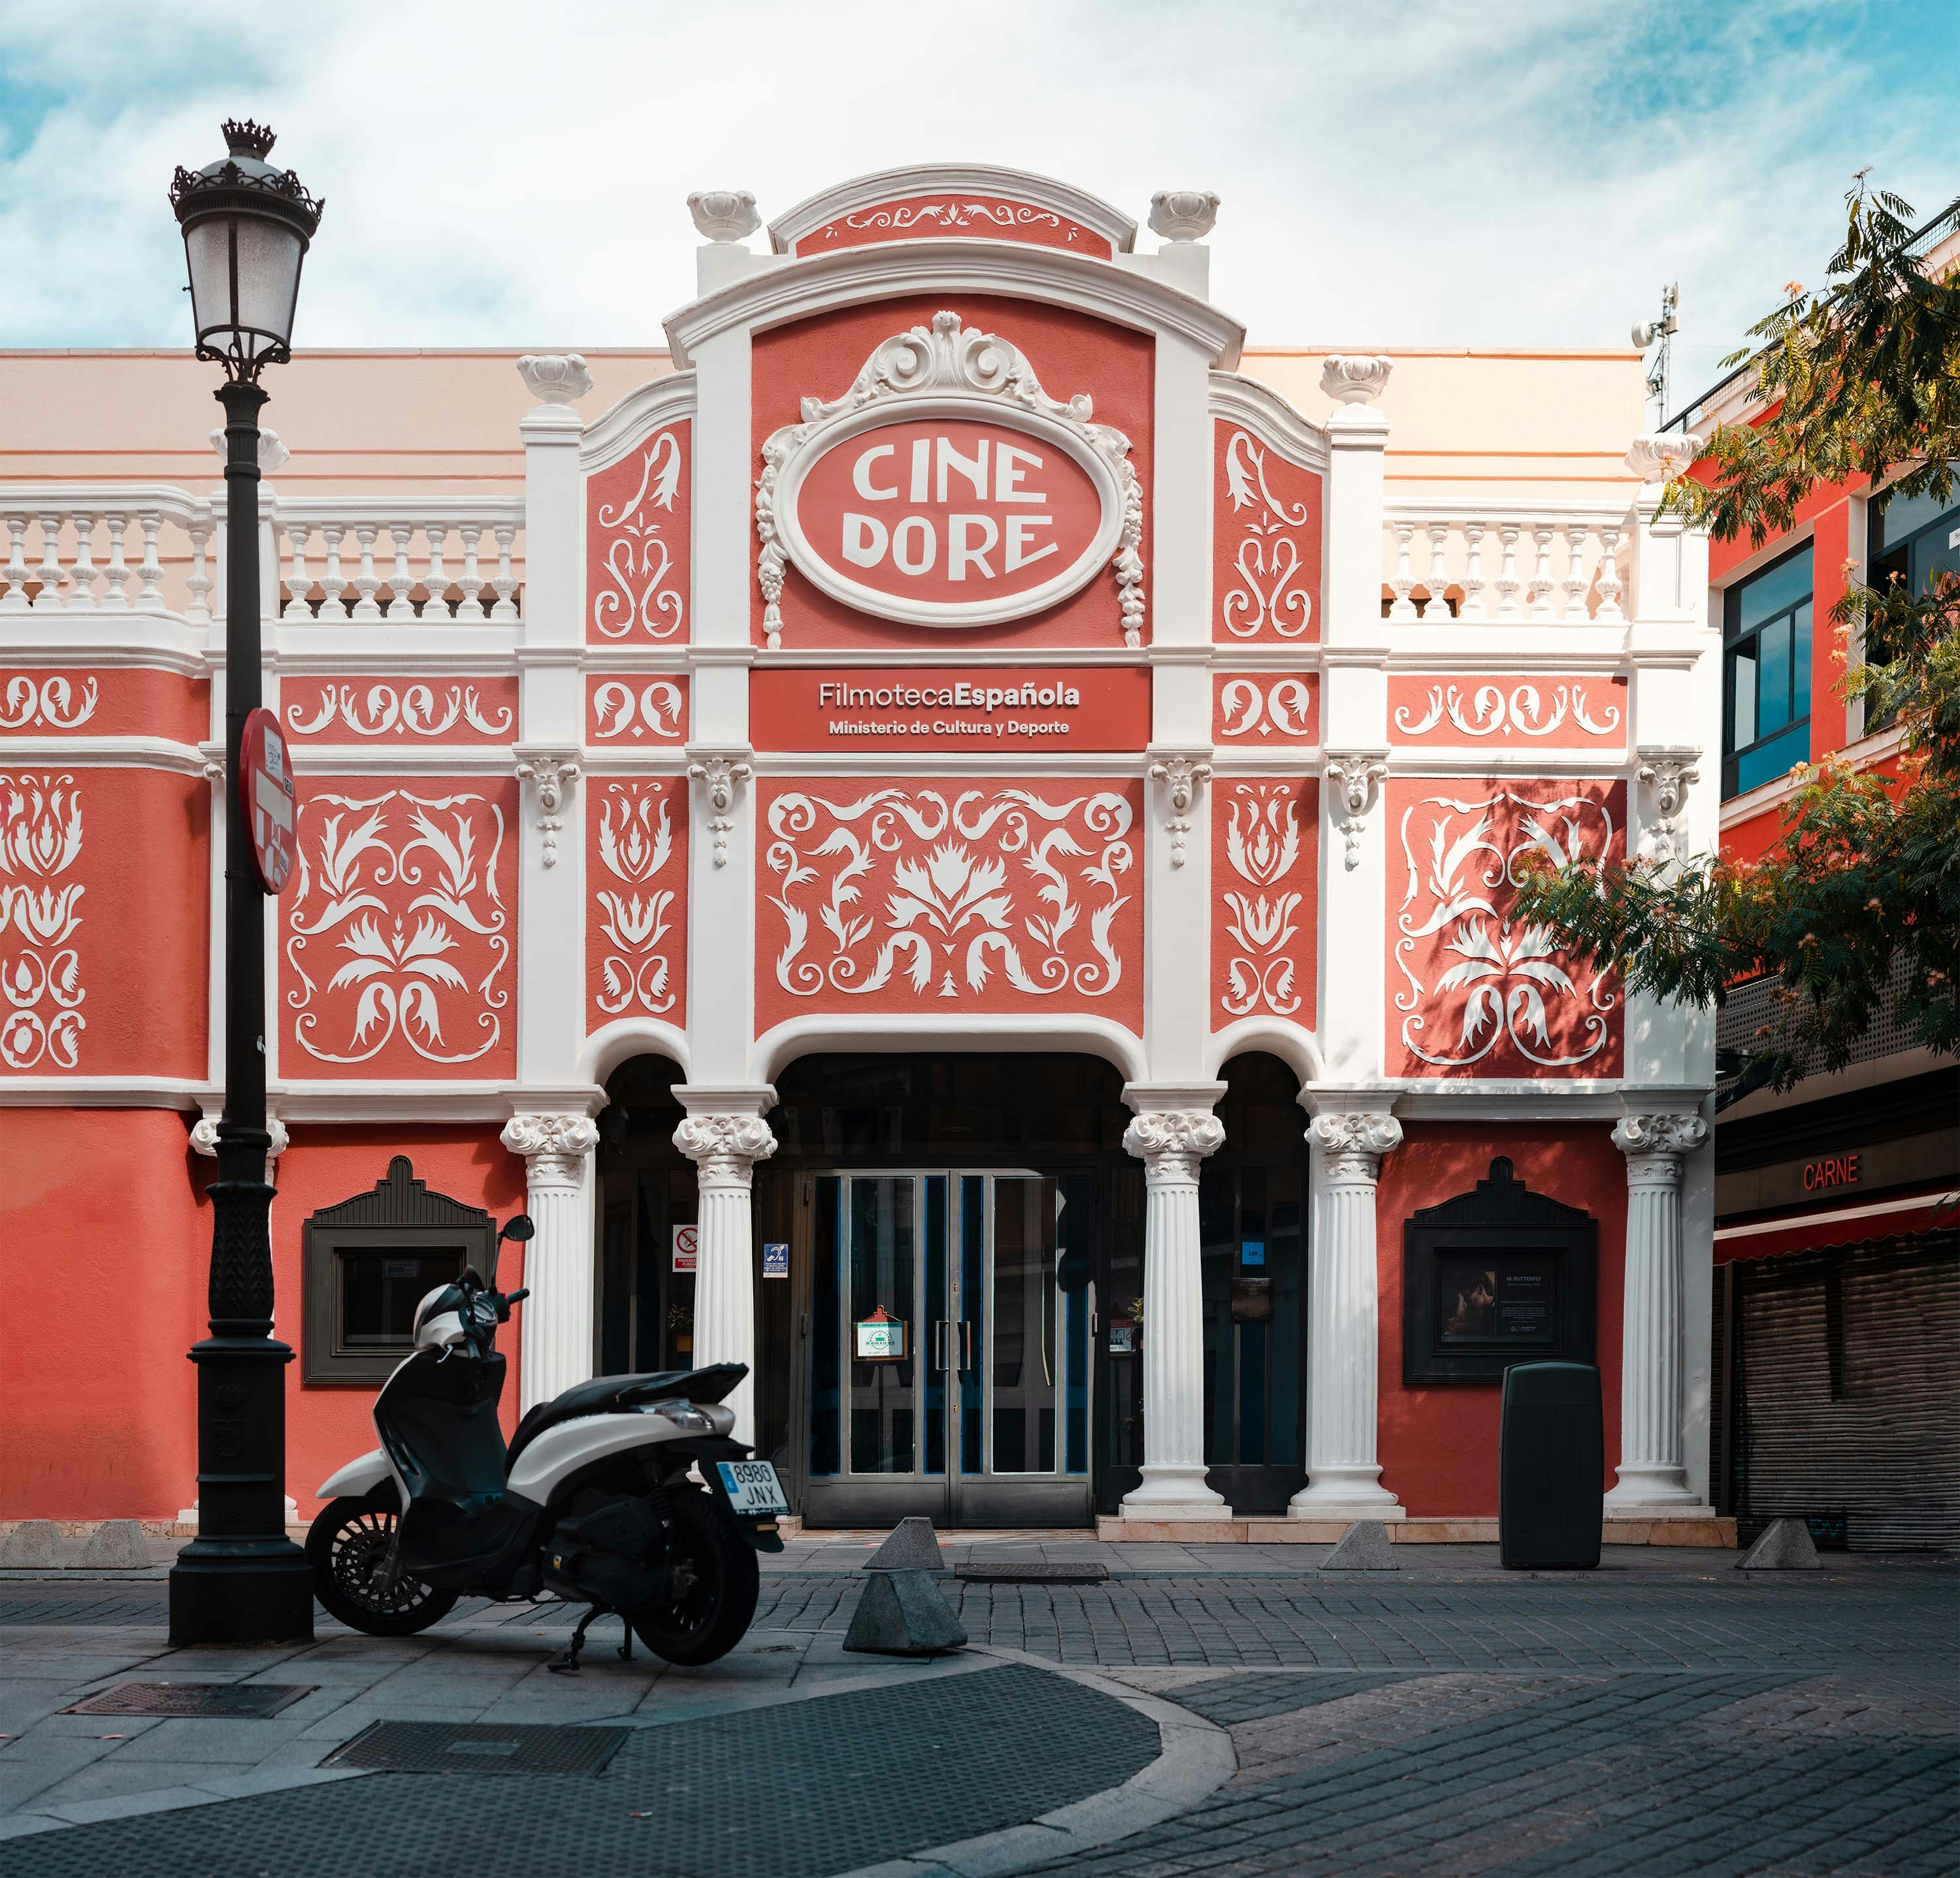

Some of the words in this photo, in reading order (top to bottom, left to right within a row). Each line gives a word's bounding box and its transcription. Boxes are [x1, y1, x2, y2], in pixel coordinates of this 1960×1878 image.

[853, 436, 1047, 503] CINE
[842, 512, 1058, 581] DORE
[819, 681, 1080, 711] FilmotecaEspañola
[829, 720, 907, 734] Ministerio
[910, 721, 930, 734] de
[932, 720, 992, 734] Cultura
[995, 723, 1005, 737] y
[1007, 721, 1070, 737] Deporte
[1803, 1155, 1858, 1191] CARNE
[747, 1485, 779, 1505] JNX
